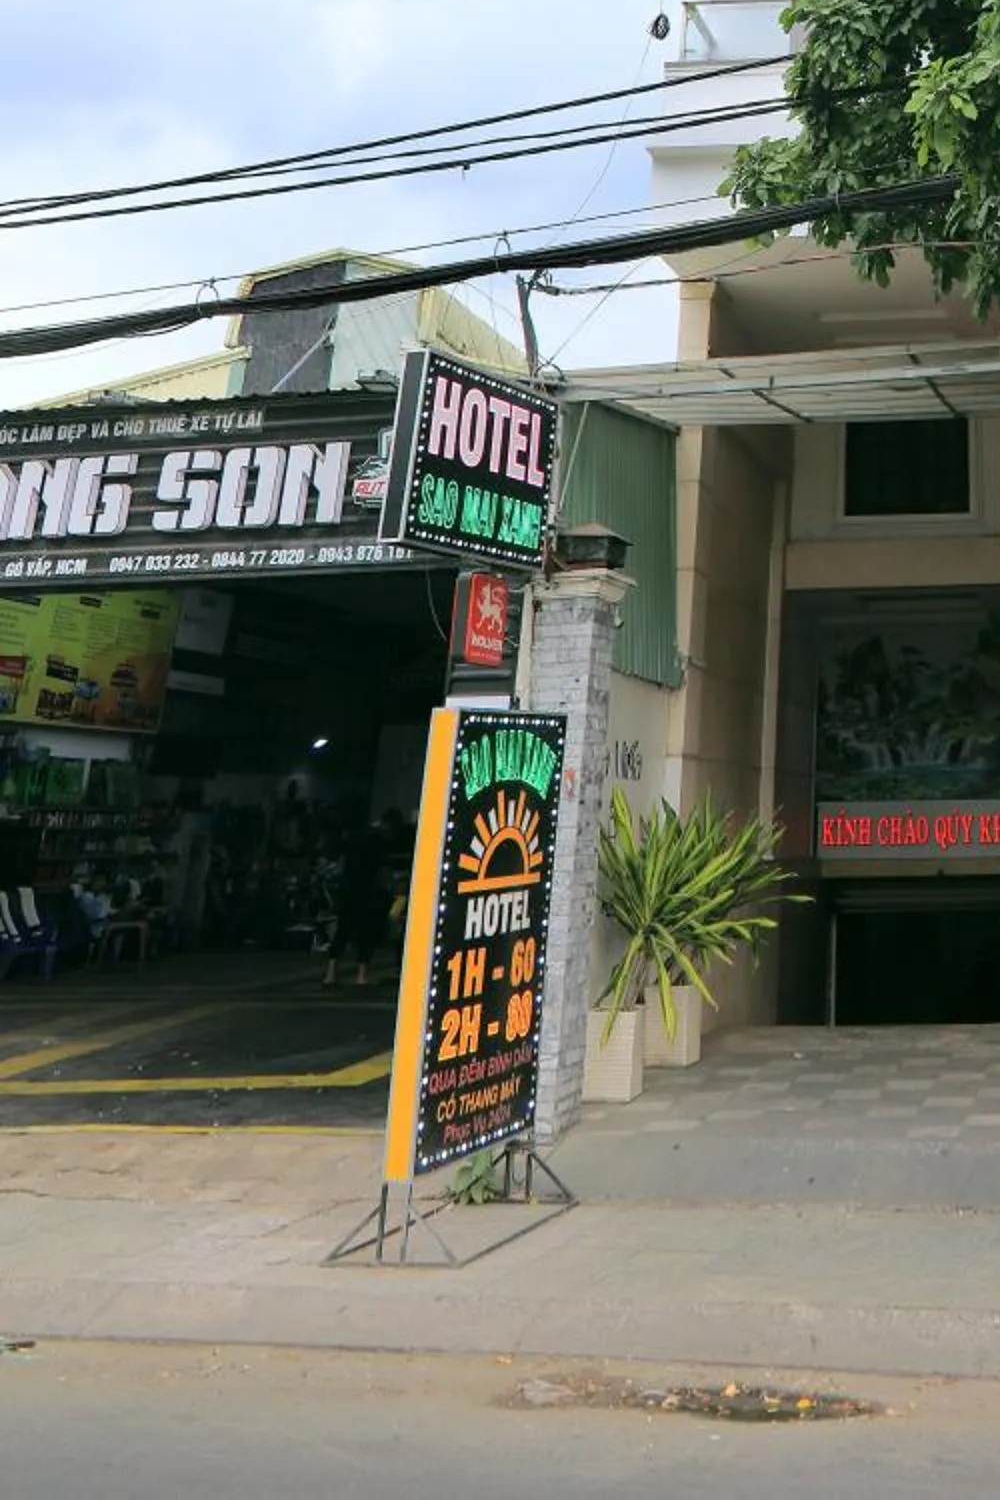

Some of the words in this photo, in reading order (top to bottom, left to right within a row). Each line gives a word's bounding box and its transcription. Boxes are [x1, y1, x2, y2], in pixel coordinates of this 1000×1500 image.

[113, 419, 145, 437] CHO
[190, 415, 210, 432] XE
[428, 375, 544, 487] HOTEL
[418, 473, 459, 529] SAO
[55, 558, 88, 575] HCM
[174, 552, 200, 569] 232
[250, 550, 267, 565] 77
[270, 547, 305, 565] 2020
[822, 807, 873, 846] KÍNH
[464, 890, 531, 940] HOTEL
[447, 947, 487, 1001] 1H
[511, 937, 536, 987] 60
[438, 1003, 483, 1061] 2H
[437, 1092, 457, 1123] CÓ
[459, 1085, 499, 1117] THANG
